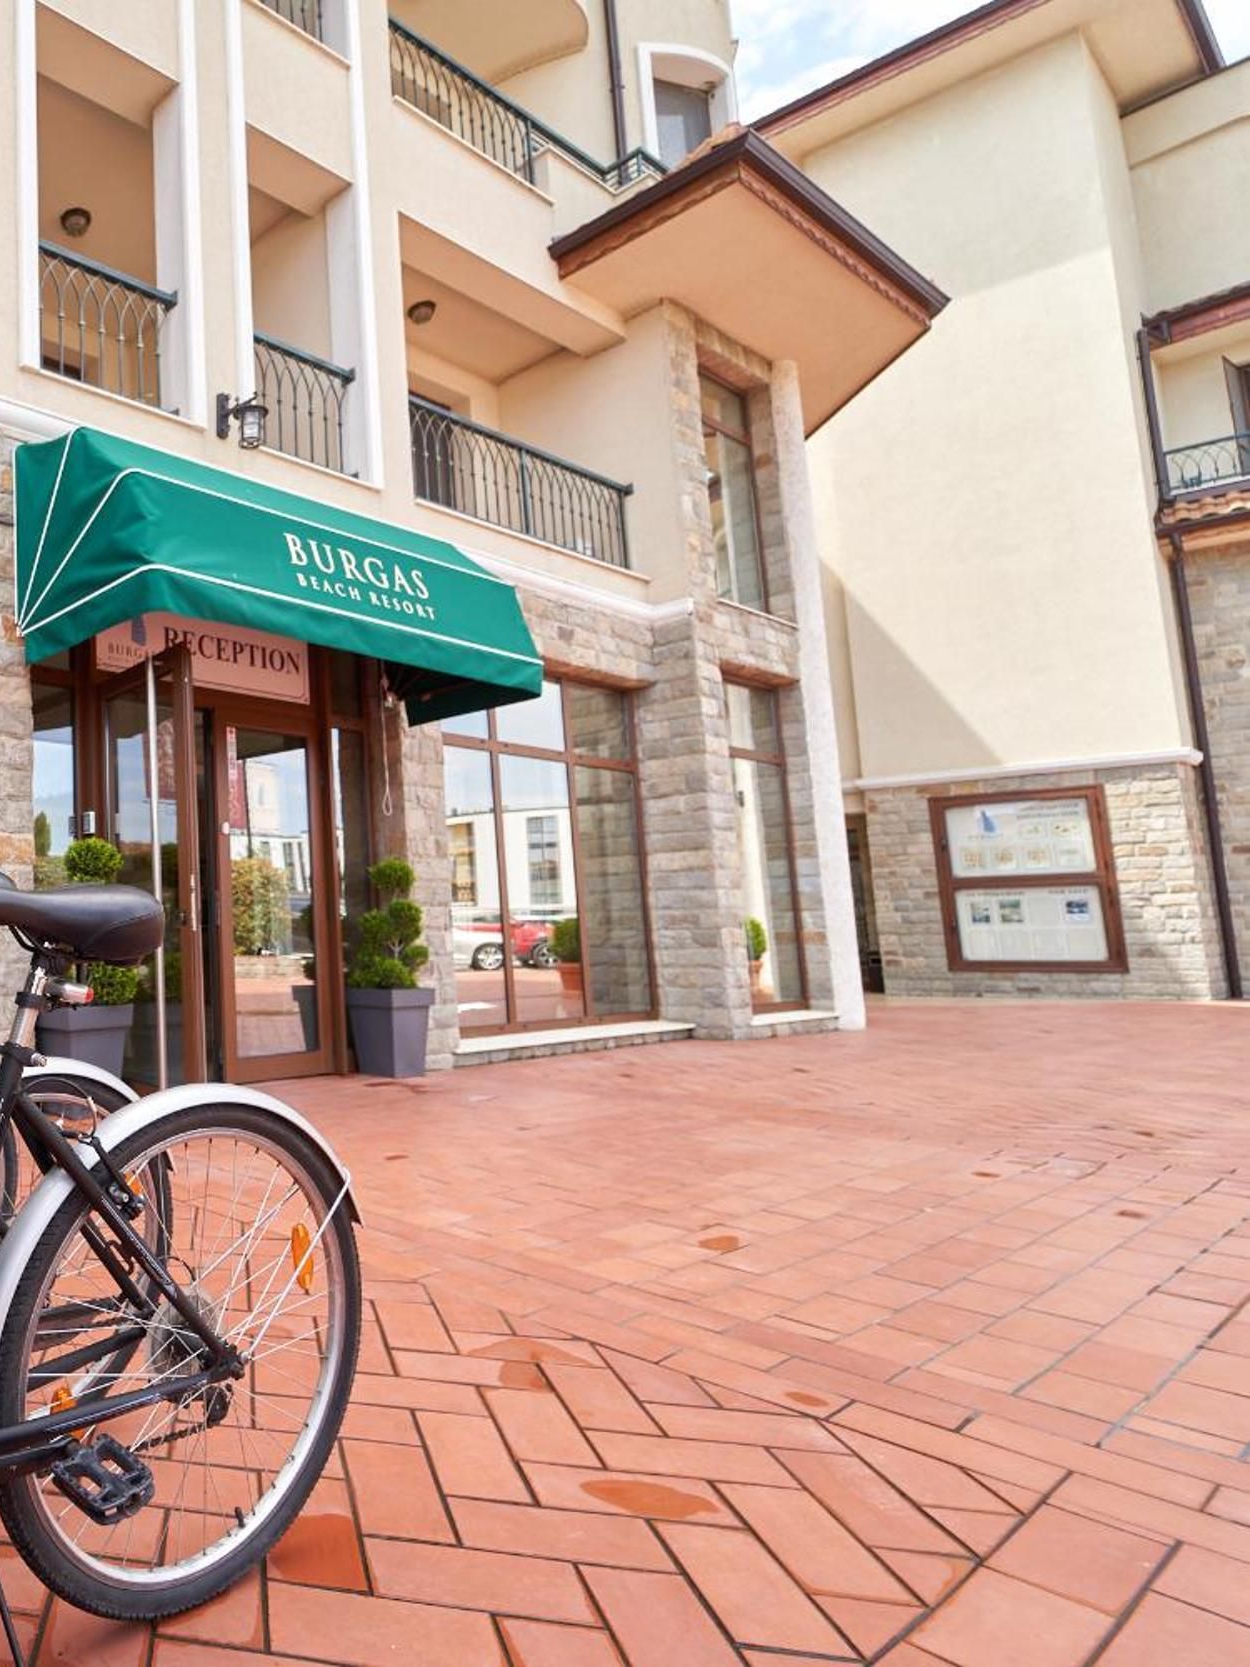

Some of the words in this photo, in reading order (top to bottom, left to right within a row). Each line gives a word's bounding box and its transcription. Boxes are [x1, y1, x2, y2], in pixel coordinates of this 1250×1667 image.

[283, 532, 429, 599] BURGAS
[296, 572, 361, 601] BEACH
[369, 590, 436, 621] RESORT
[164, 626, 301, 675] RECEPTION
